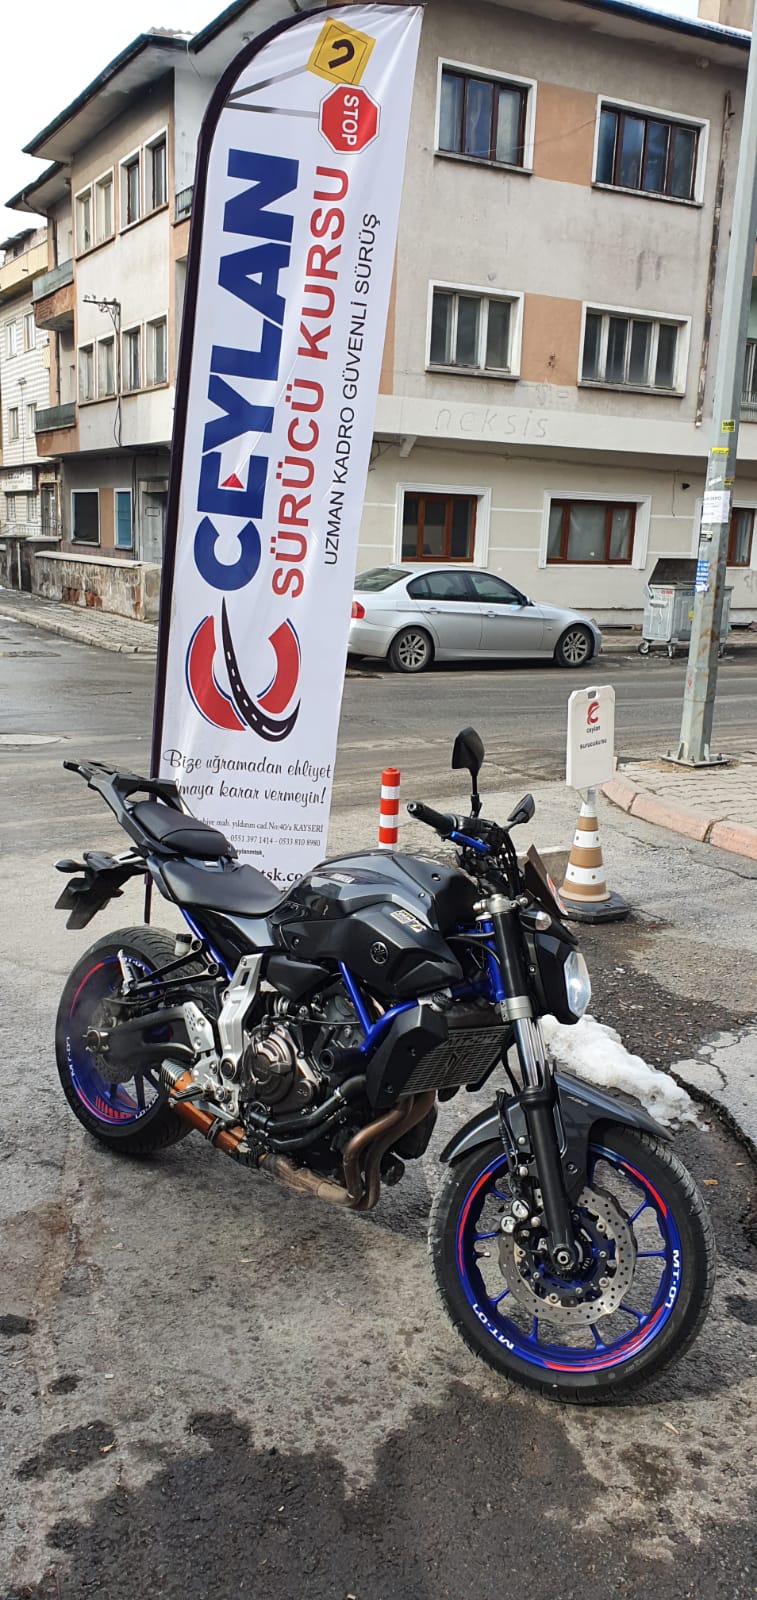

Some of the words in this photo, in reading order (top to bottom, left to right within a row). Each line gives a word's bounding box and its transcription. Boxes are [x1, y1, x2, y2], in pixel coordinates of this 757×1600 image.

[342, 94, 359, 145] STOP
[354, 213, 380, 295] SÜRÜŞ
[193, 148, 299, 591] CEYLAN
[270, 378, 324, 598] SÜRÜCÜ
[297, 166, 349, 360] KURSU
[342, 301, 367, 400] GÜVENLİ
[332, 407, 355, 485] KADRO
[325, 491, 345, 565] UZMAN
[163, 749, 202, 773] Bize
[206, 755, 282, 774] uğramadan
[287, 760, 332, 782] ehliyet
[175, 778, 214, 797] lmaya
[219, 780, 259, 799] karar
[264, 787, 327, 808] vermeyin!
[665, 1250, 680, 1308] MT-07
[473, 1303, 514, 1349] MT-07
